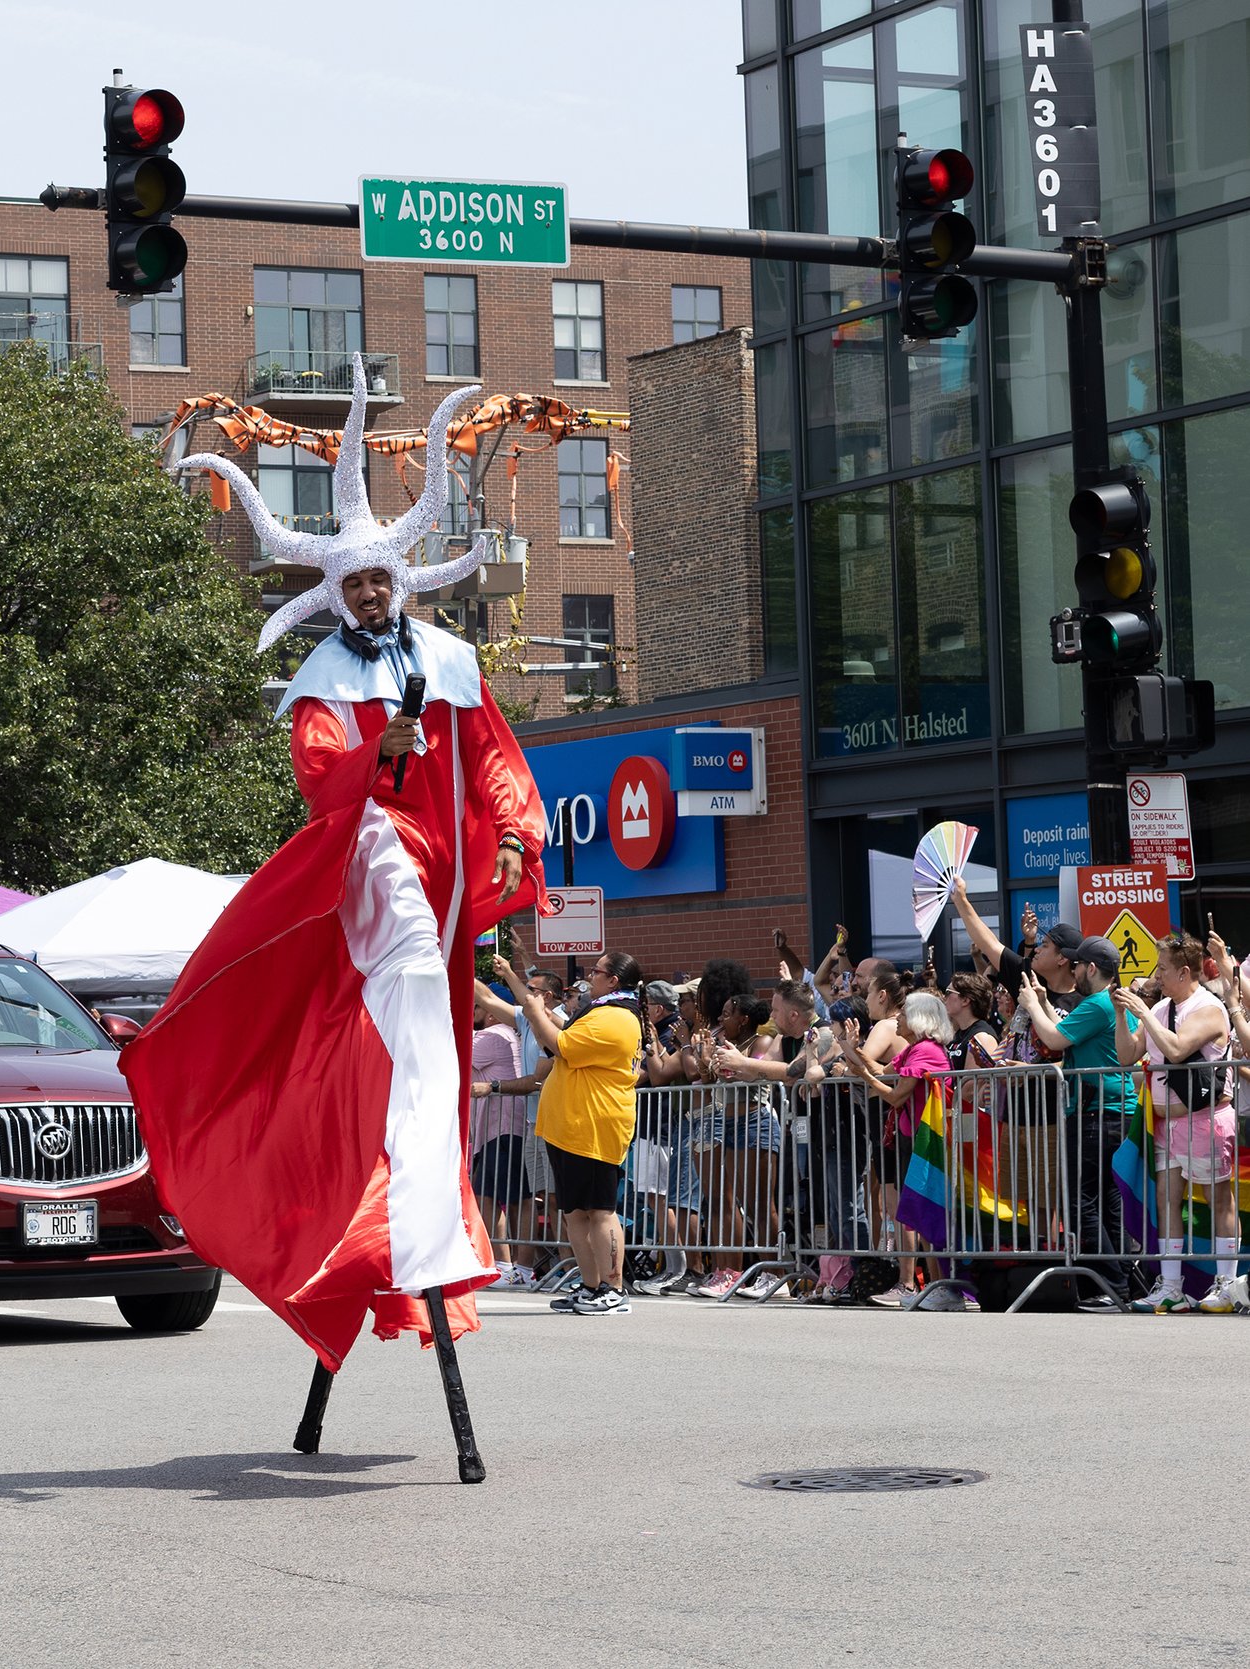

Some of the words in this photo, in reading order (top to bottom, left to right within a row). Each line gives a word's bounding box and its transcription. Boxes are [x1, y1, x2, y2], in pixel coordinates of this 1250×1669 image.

[1026, 29, 1061, 232] HA3601
[371, 193, 386, 214] W
[397, 189, 524, 226] ADDISON
[534, 200, 556, 222] ST
[419, 228, 483, 252] 3600
[500, 231, 513, 254] N
[843, 720, 877, 750] 3601
[881, 718, 899, 744] N.
[903, 707, 968, 741] Halsted
[692, 755, 725, 767] BMO
[710, 796, 735, 809] ATM
[541, 793, 596, 848] MO
[1131, 813, 1141, 821] ON
[1144, 812, 1177, 821] SIDEWALK
[1023, 825, 1063, 847] Deposit
[1066, 821, 1090, 841] rain
[1024, 850, 1060, 871] Change
[1064, 848, 1090, 866] lives.
[1092, 871, 1153, 887] STREET
[1083, 888, 1165, 906] CROSSING
[1037, 902, 1056, 913] every
[544, 943, 565, 952] TOW
[568, 942, 599, 952] ZONE
[52, 1216, 77, 1235] RDG
